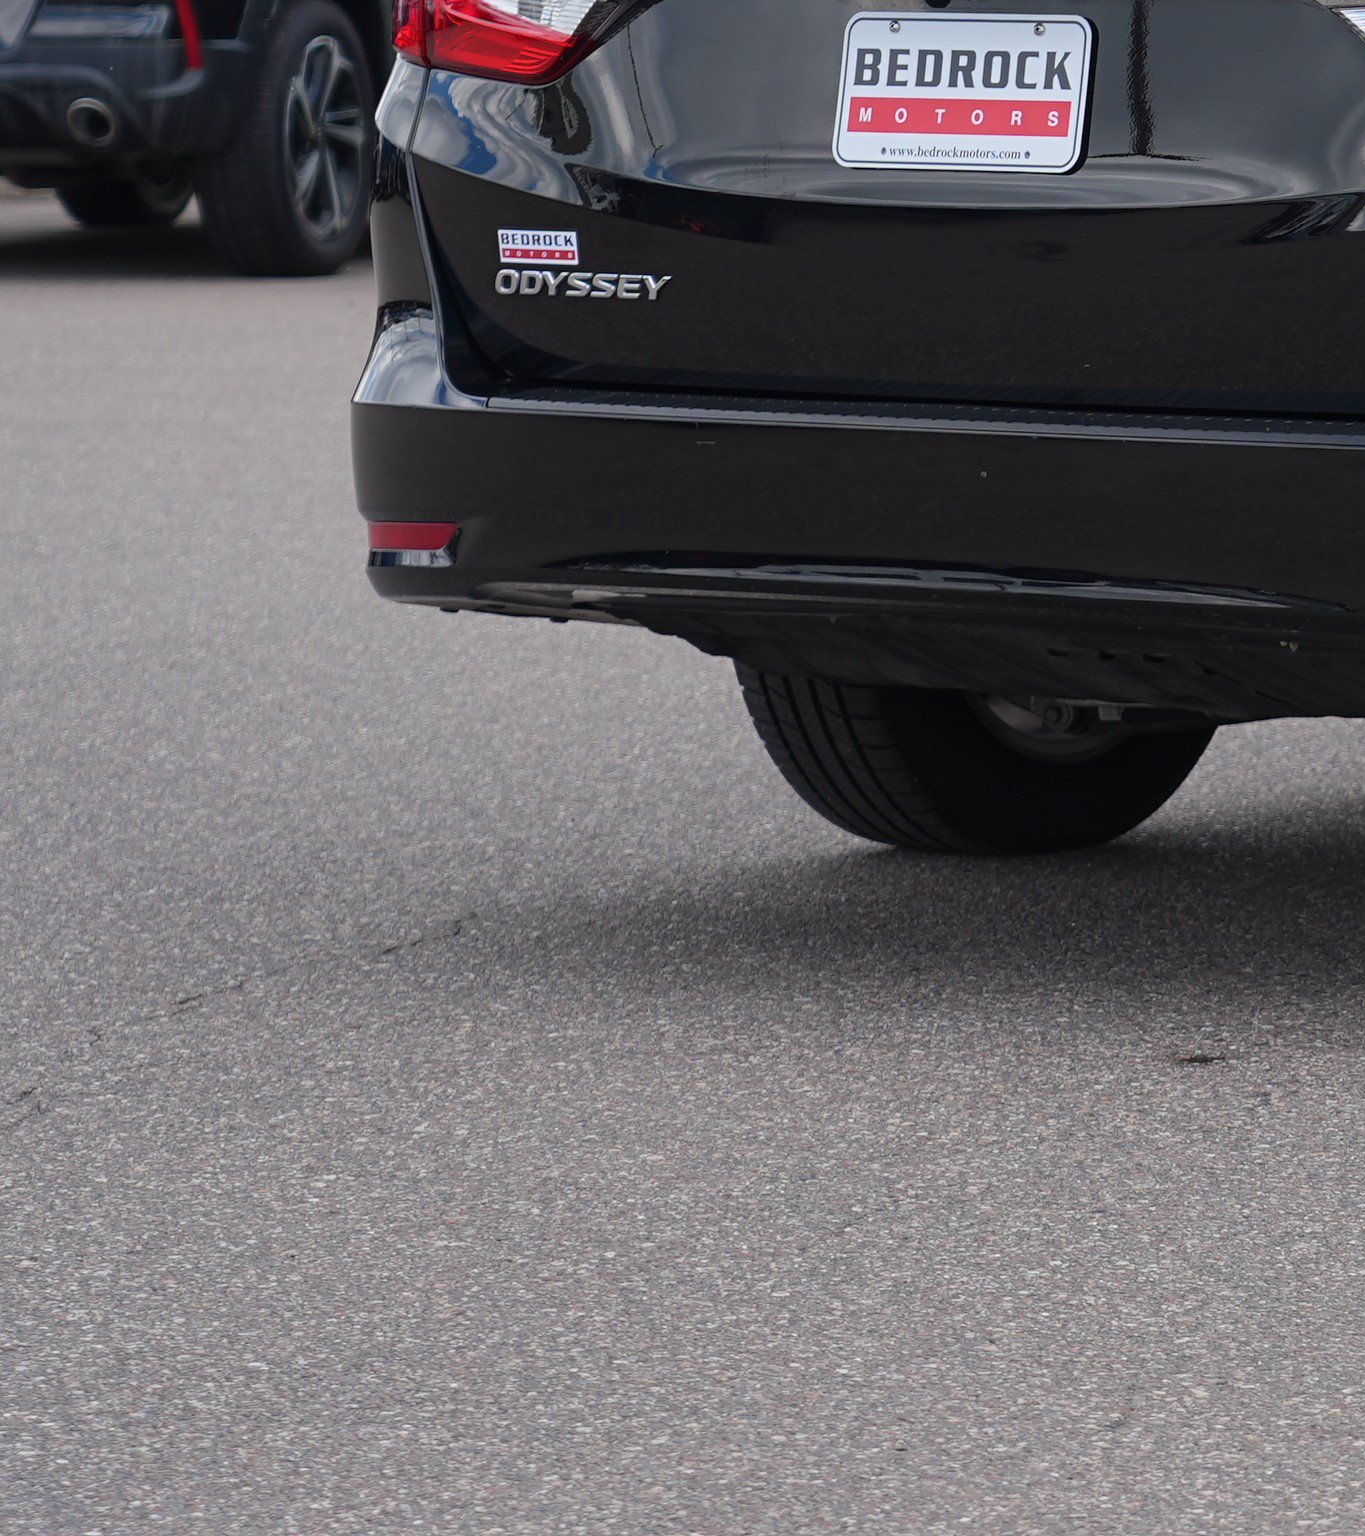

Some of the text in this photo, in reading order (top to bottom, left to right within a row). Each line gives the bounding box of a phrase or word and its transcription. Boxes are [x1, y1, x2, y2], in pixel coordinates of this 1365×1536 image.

[853, 48, 1072, 90] BEDROCK
[859, 107, 1060, 128] MOTORS
[889, 146, 1021, 160] www.bedrockmotors.com
[501, 232, 575, 247] BEDROCK
[504, 250, 574, 259] MOTORS
[495, 268, 673, 301] ODYSSEY
